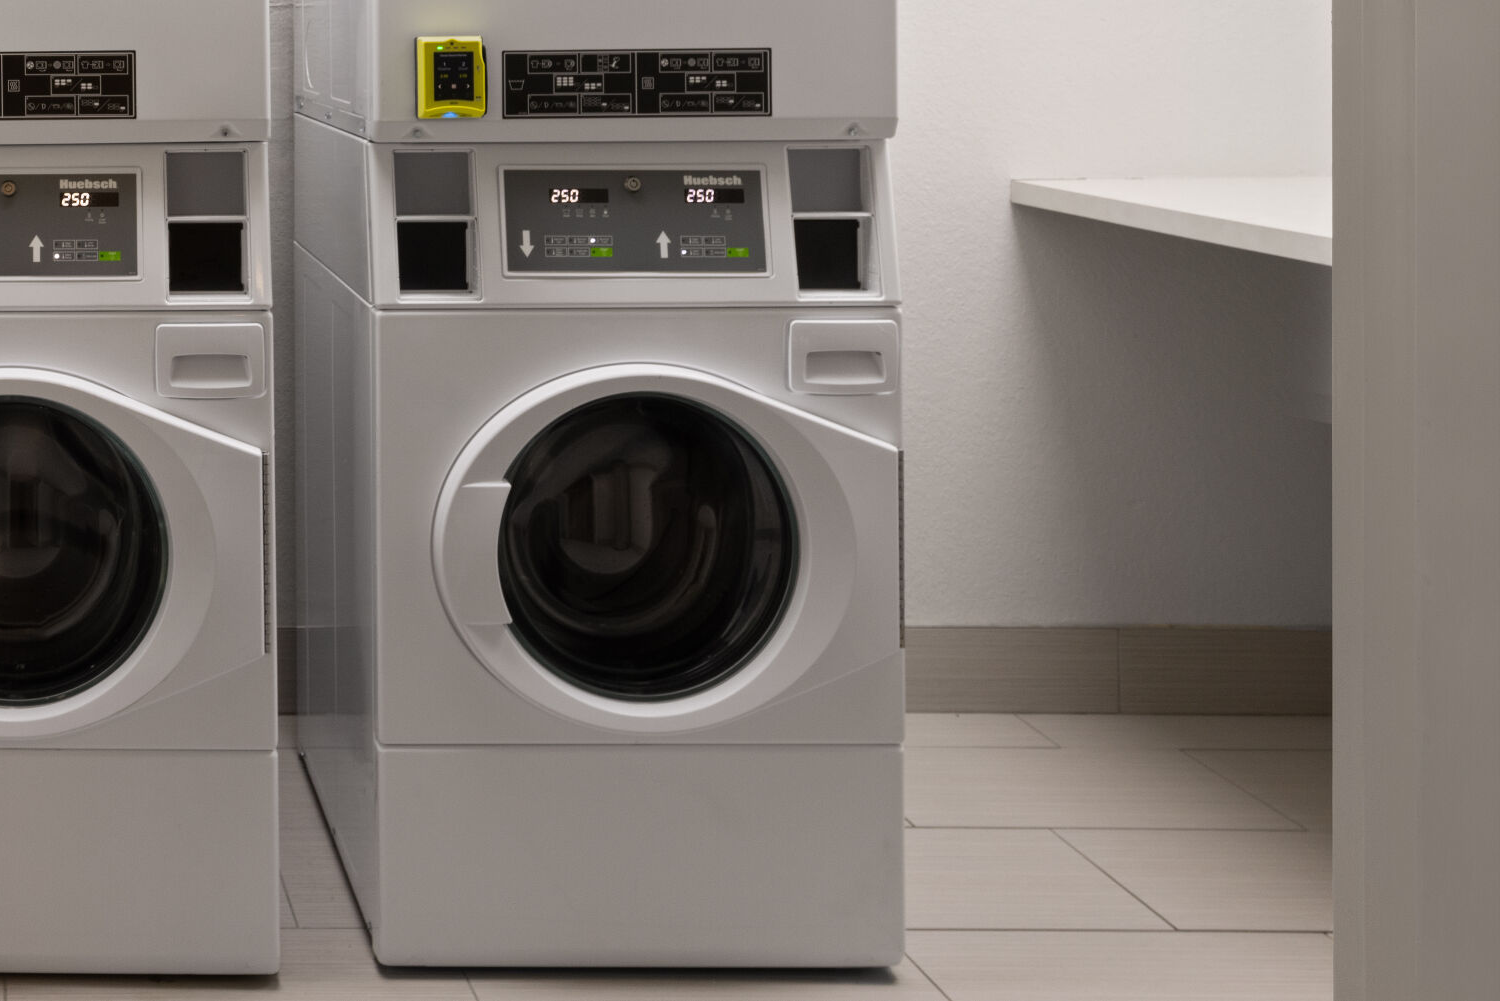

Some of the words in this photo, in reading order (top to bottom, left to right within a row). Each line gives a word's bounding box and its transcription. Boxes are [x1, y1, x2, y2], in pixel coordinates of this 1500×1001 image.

[59, 178, 117, 189] Huebsch
[683, 175, 742, 186] Huebsch
[61, 192, 91, 207] 250
[551, 188, 580, 203] 250
[686, 188, 715, 203] 250
